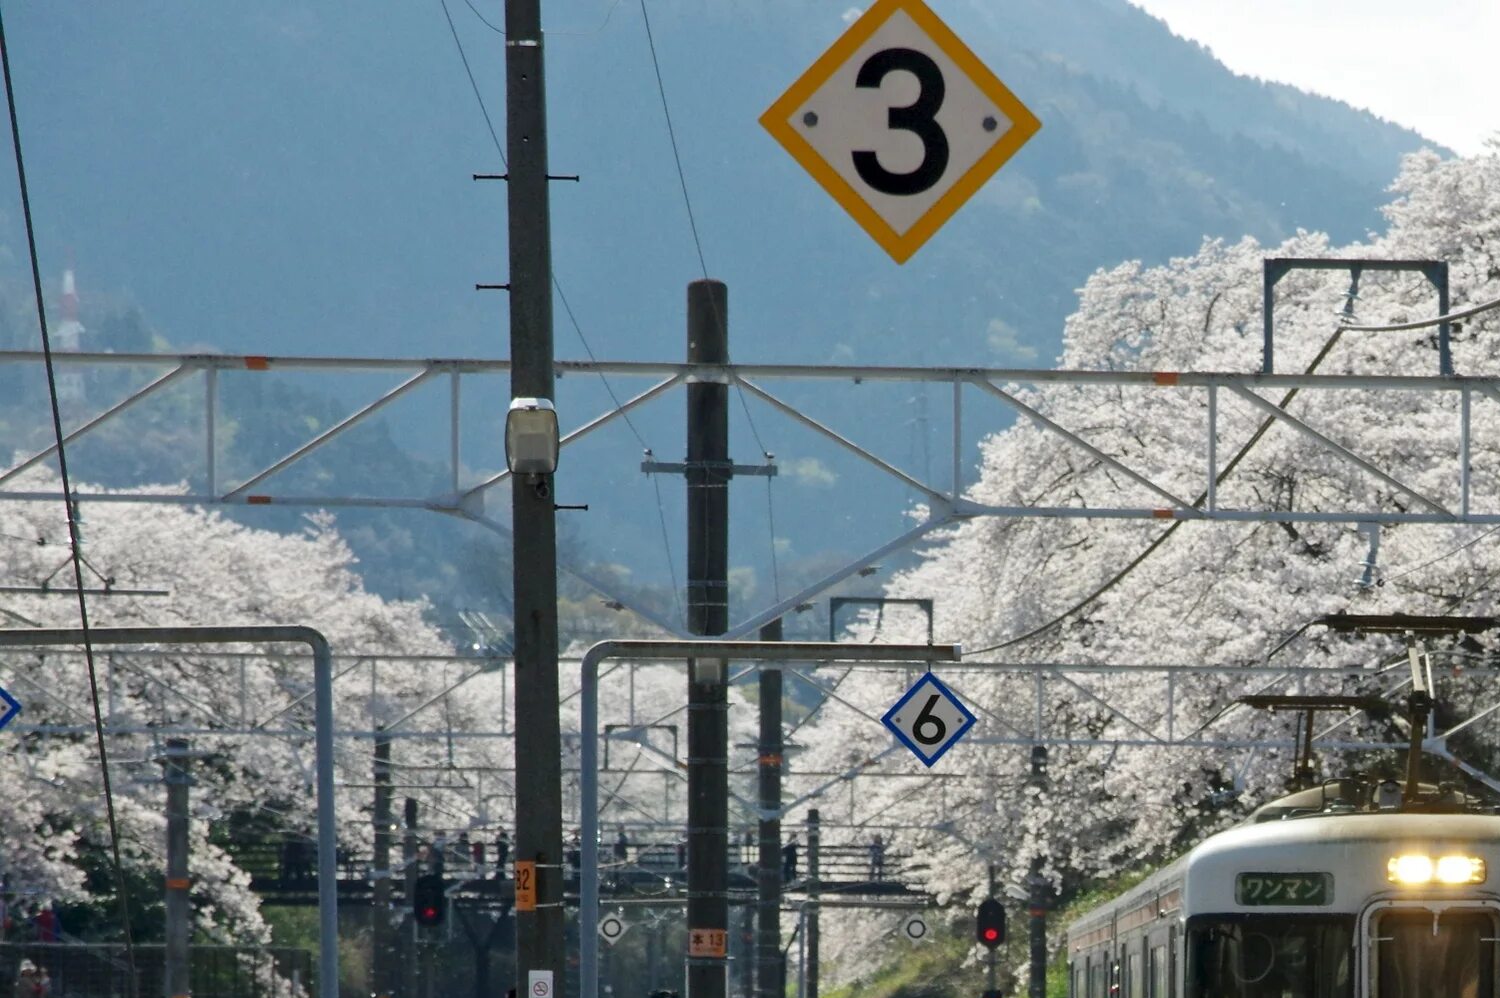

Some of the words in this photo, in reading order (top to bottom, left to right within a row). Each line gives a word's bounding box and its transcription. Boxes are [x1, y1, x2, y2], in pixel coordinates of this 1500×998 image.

[851, 47, 950, 197] 3
[912, 694, 947, 746] 6
[1246, 878, 1323, 899] ワンマン
